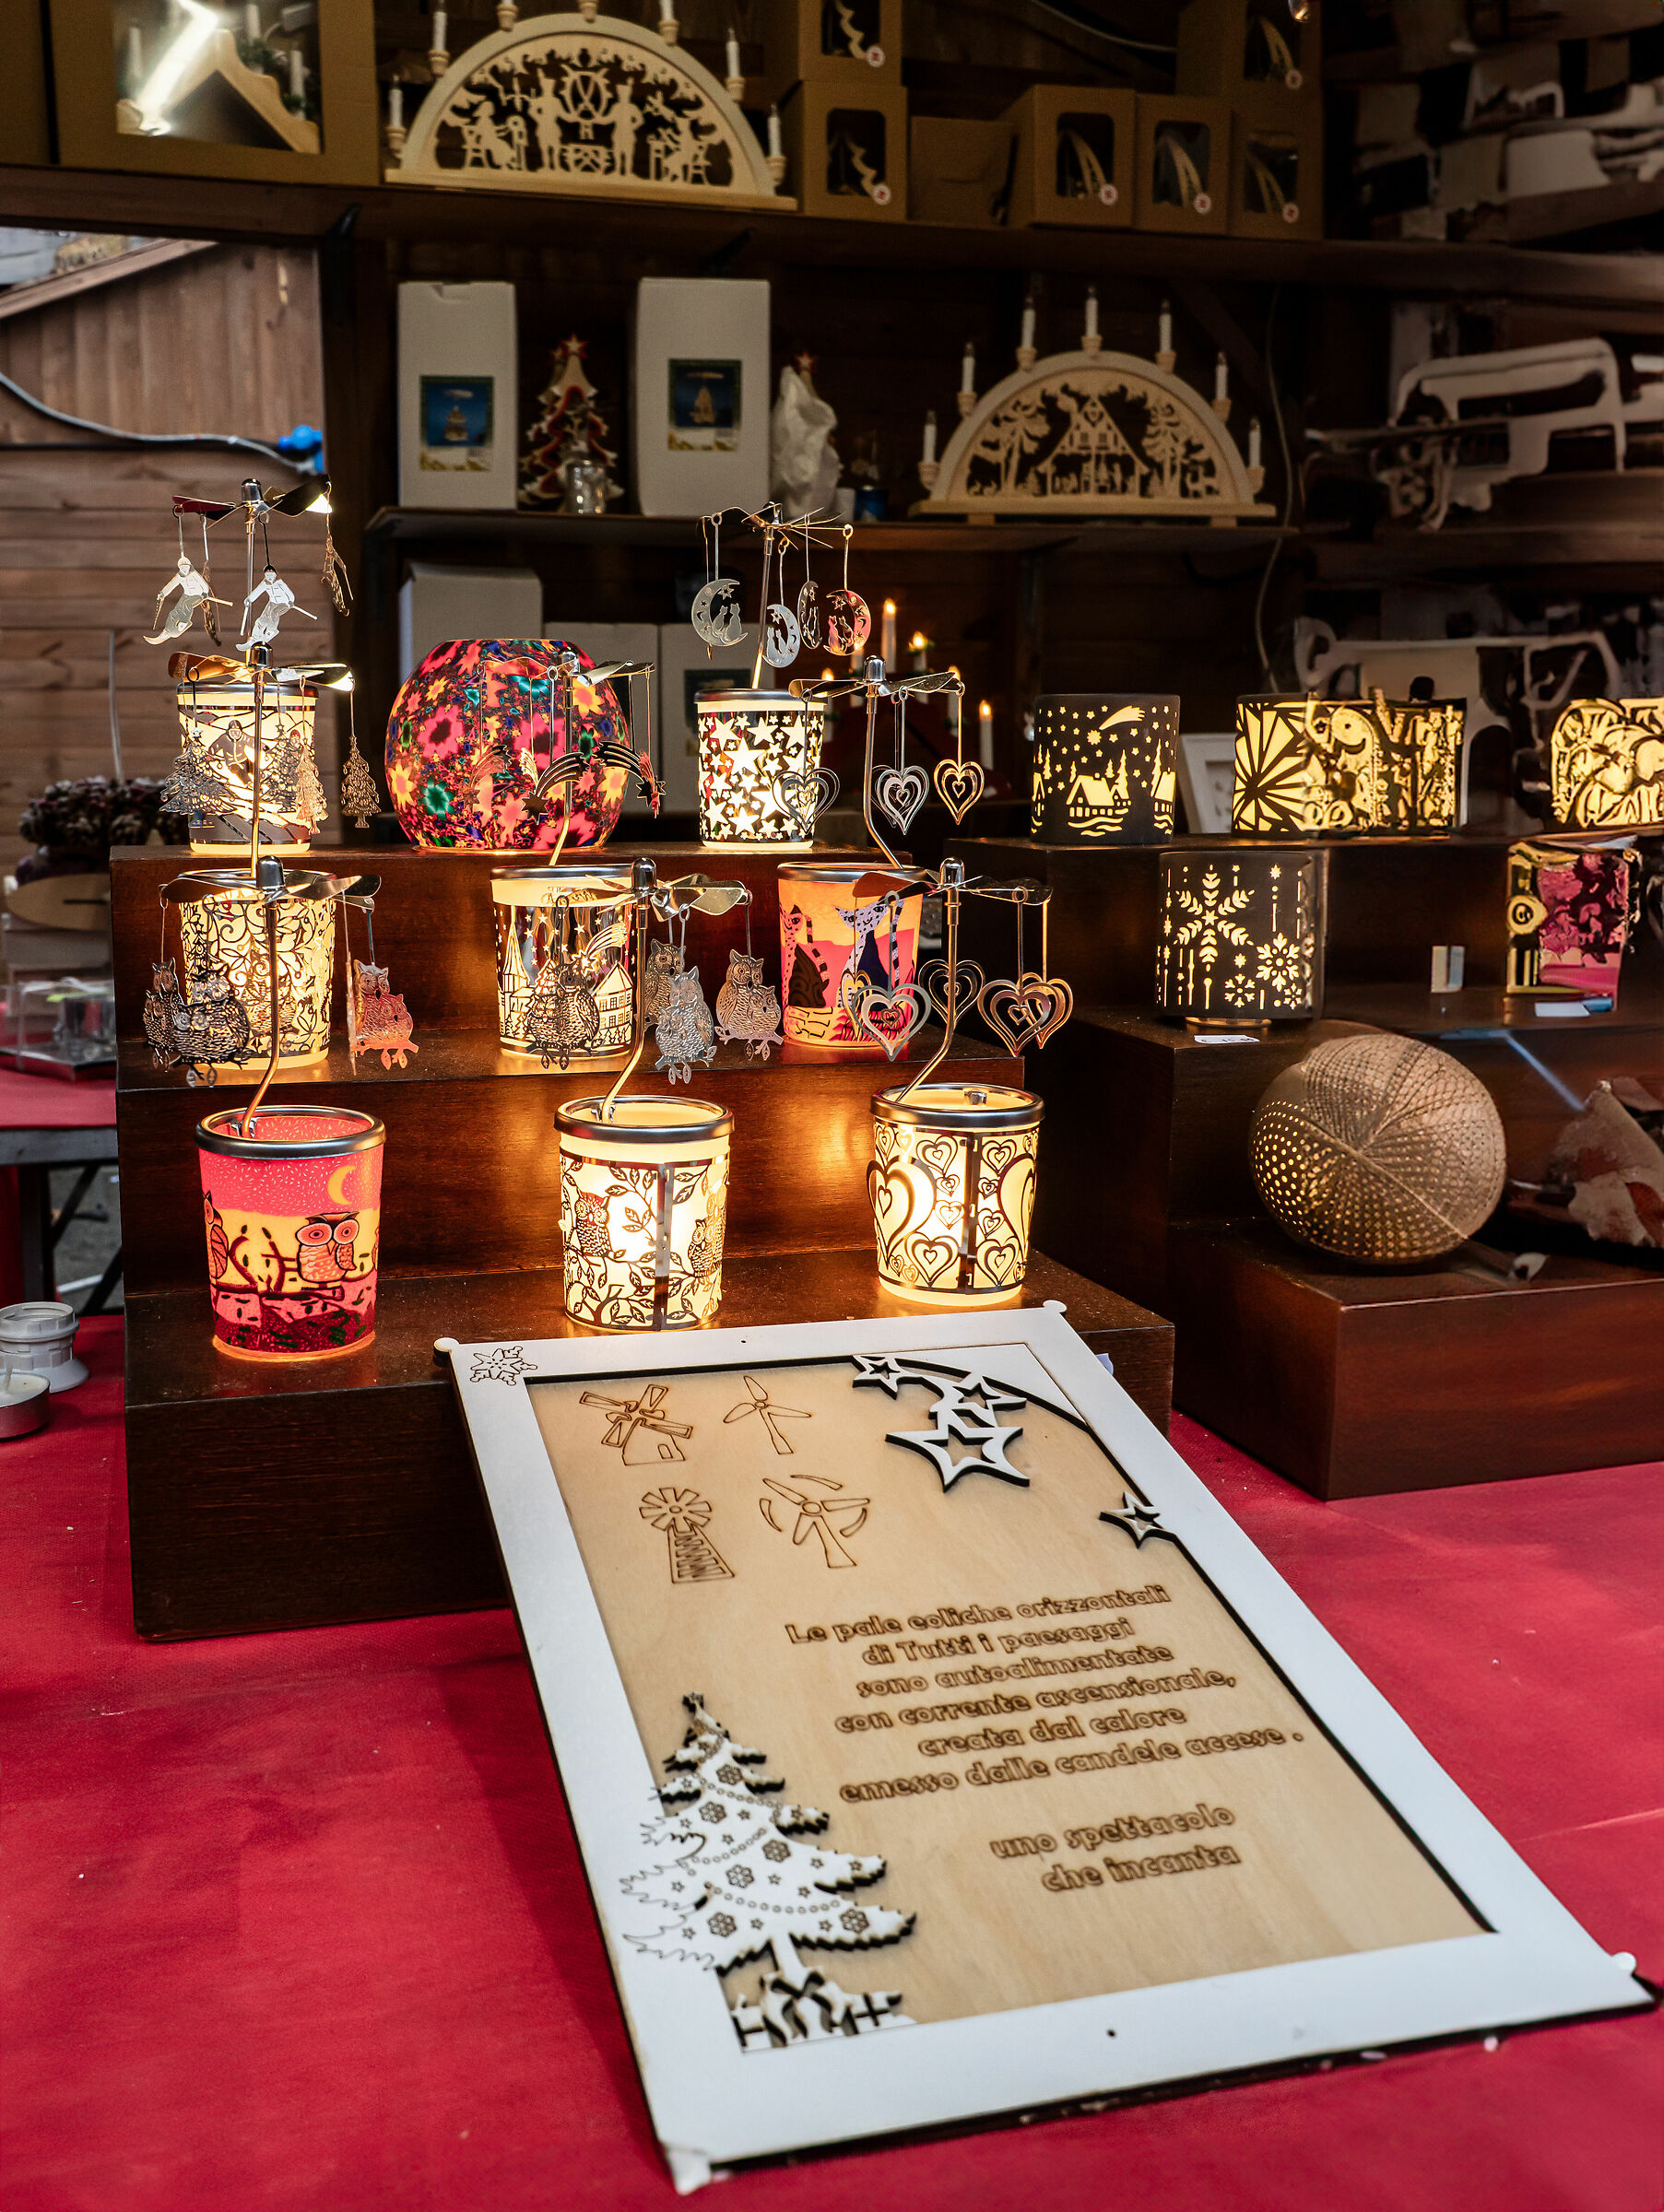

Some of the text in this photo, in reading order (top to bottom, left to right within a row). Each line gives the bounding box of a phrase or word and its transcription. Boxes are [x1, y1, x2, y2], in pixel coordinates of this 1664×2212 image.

[785, 1584, 1173, 1644] Le pale eoliche orizzontali
[862, 1617, 1136, 1665] di Tutti i paesaggi
[856, 1645, 1174, 1698] sono autoalimentate
[834, 1667, 1236, 1733] con corrente ascensionale,
[918, 1707, 1186, 1757] creata dal calore
[839, 1772, 960, 1803] emesso
[965, 1757, 1051, 1786] dalle
[1055, 1738, 1182, 1773] candele
[1185, 1727, 1286, 1756] accese
[989, 1803, 1235, 1859] uno spettacolo
[1041, 1844, 1241, 1892] che incanta
